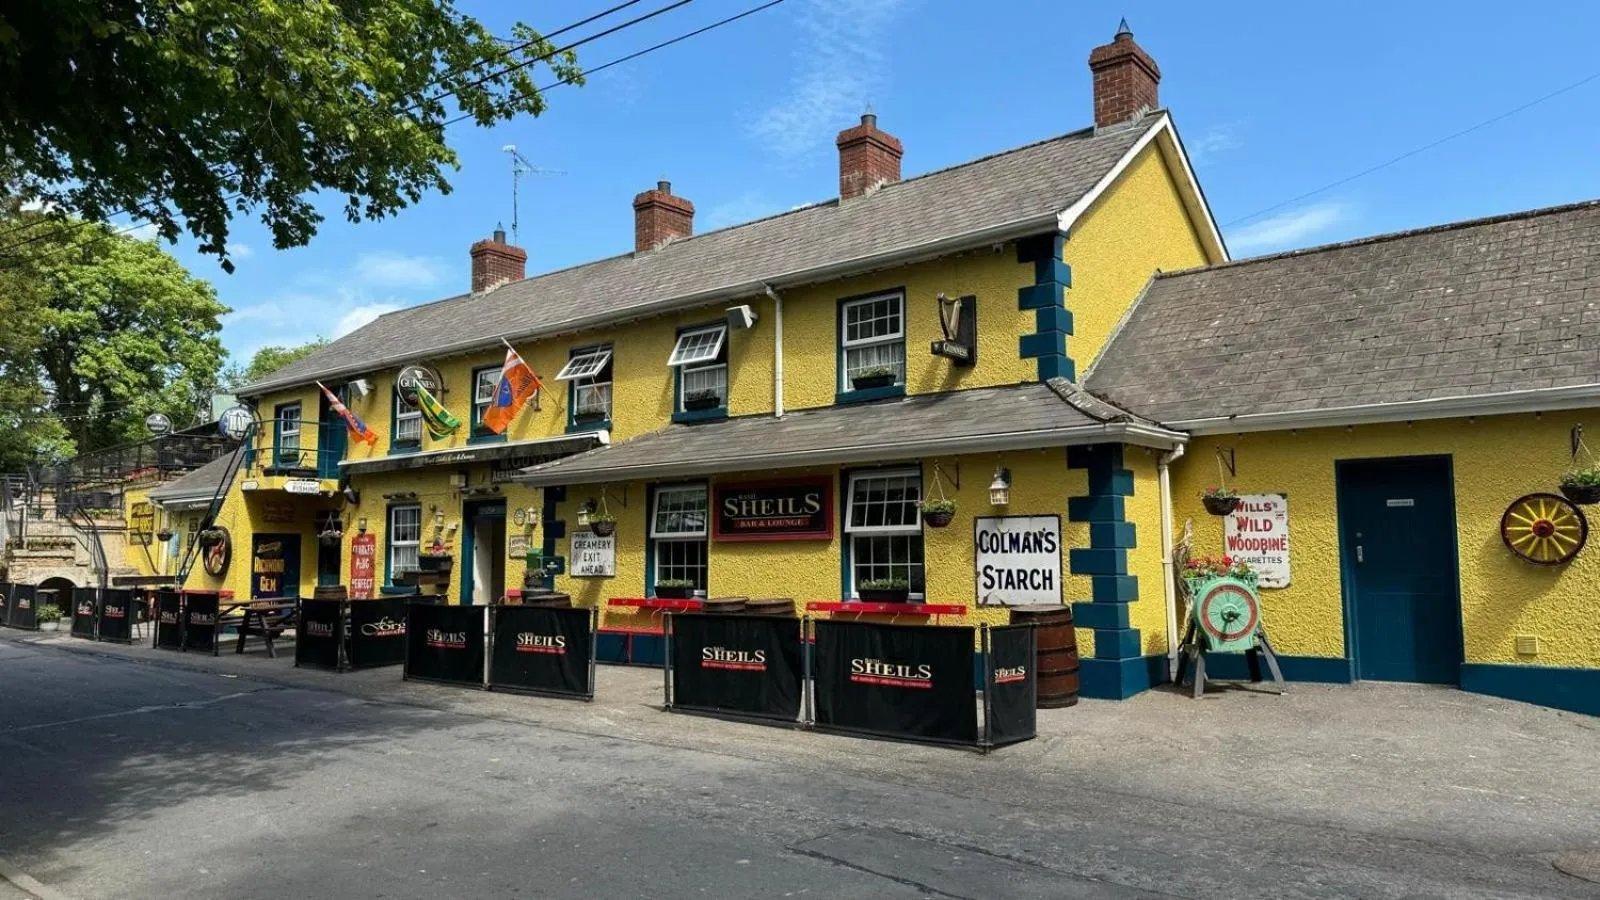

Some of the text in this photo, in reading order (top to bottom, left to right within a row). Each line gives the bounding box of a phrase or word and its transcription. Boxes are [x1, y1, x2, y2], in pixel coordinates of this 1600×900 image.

[723, 493, 820, 517] SHEILS
[741, 520, 757, 528] BAR
[767, 519, 802, 527] LOUNGE
[574, 540, 611, 549] CREAMERY
[978, 528, 1056, 554] COLMAN'S
[583, 552, 600, 562] EXIT
[1233, 555, 1282, 564] CIGARETTES
[581, 565, 604, 574] AHEAD
[983, 565, 1053, 590] STARCH
[516, 632, 566, 648] SHEILS
[702, 646, 766, 663] SHEILS
[851, 658, 932, 679] SHEILS
